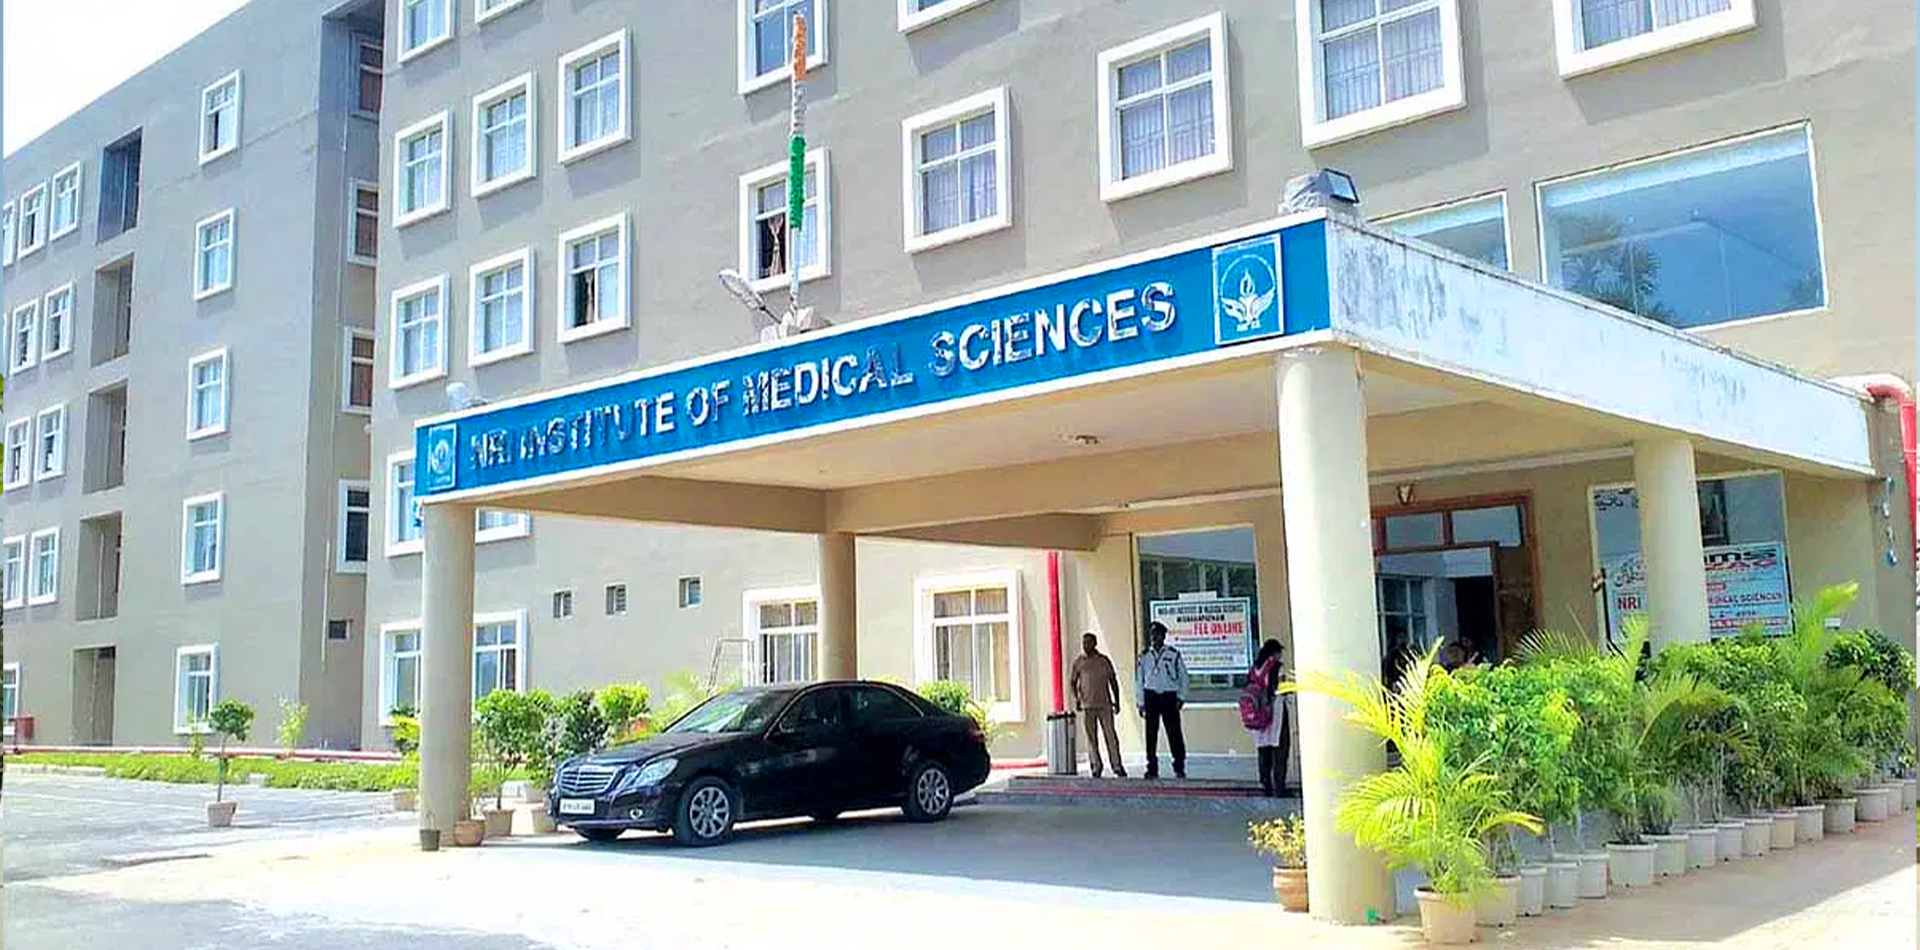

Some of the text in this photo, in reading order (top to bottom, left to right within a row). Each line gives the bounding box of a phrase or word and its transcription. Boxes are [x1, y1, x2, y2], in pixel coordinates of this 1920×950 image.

[470, 281, 1177, 470] NRI INSTITUTE OF MEDICAL SCIENCES
[1617, 596, 1642, 610] NRI
